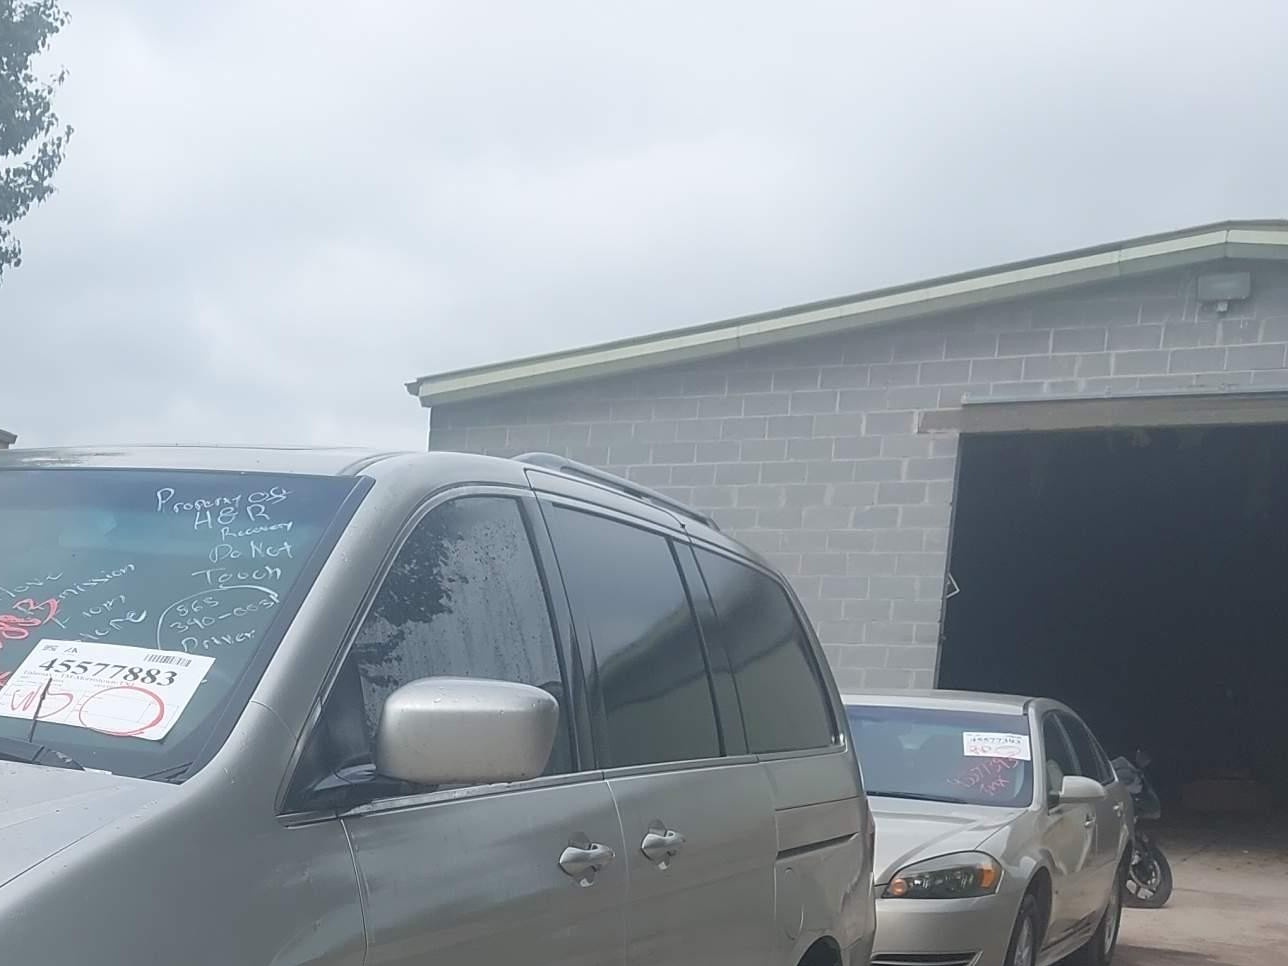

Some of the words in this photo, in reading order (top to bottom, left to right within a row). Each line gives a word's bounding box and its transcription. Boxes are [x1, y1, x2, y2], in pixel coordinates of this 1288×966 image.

[194, 511, 213, 529] H
[247, 504, 271, 521] R
[209, 544, 241, 563] Do
[250, 540, 294, 559] Not
[192, 566, 282, 585] Touch
[39, 657, 179, 687] 45577883
